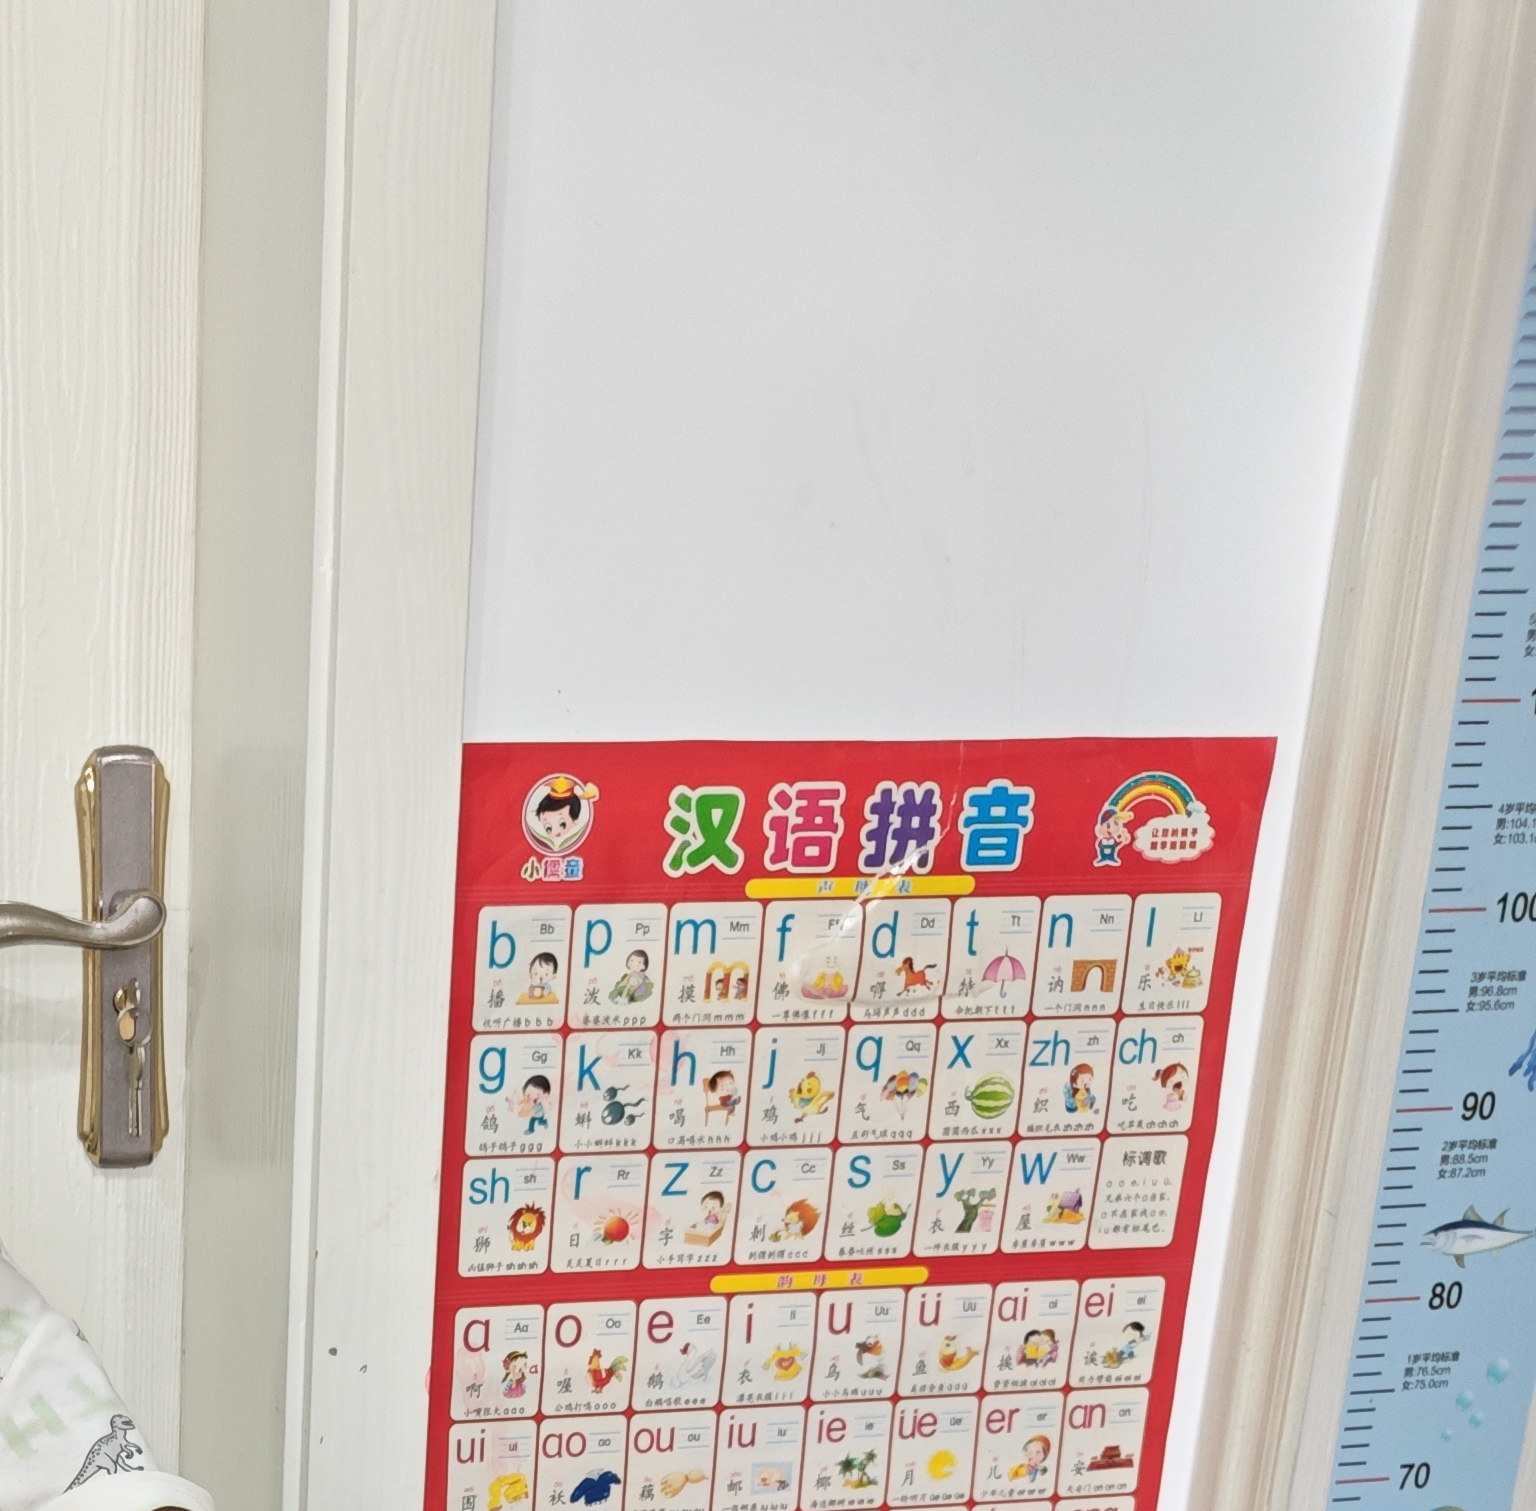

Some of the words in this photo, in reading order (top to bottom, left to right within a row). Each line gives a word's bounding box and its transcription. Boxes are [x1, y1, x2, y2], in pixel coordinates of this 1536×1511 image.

[1498, 802, 1536, 815] 4岁平均
[666, 782, 1032, 873] 汉语拼音
[539, 923, 555, 935] Bb
[635, 923, 650, 936] Pp
[729, 921, 750, 933] Mm
[872, 910, 899, 958] d
[921, 917, 935, 929] Dd
[966, 909, 979, 956] t
[1048, 912, 1073, 948] n
[1099, 913, 1115, 925] Nn
[489, 920, 516, 969] b
[584, 918, 612, 968] p
[674, 918, 717, 954] m
[776, 913, 795, 962] f
[1471, 970, 1527, 983] 3岁平均标准
[532, 1050, 548, 1064] Gg
[628, 1048, 642, 1059] Kk
[720, 1045, 736, 1057] Hh
[855, 1034, 883, 1083] q
[905, 1041, 921, 1053] Qq
[946, 1034, 975, 1069] x
[1029, 1030, 1071, 1066] zh
[1118, 1028, 1157, 1064] ch
[479, 1046, 506, 1094] g
[577, 1044, 602, 1091] k
[670, 1039, 696, 1086] h
[762, 1038, 778, 1090] j
[855, 1102, 870, 1121] 气
[944, 1100, 961, 1117] 西
[1461, 1091, 1496, 1121] 90
[1122, 1150, 1167, 1167] 标调歌
[1441, 1138, 1498, 1152] 2岁平均标准
[617, 1169, 630, 1181] Rr
[751, 1159, 776, 1193] c
[801, 1162, 816, 1174] Cc
[847, 1155, 871, 1188] s
[892, 1160, 906, 1172] Ss
[935, 1152, 964, 1198] y
[981, 1156, 994, 1169] Yy
[1020, 1152, 1058, 1185] w
[468, 1167, 510, 1205] sh
[574, 1166, 592, 1200] r
[661, 1162, 689, 1196] z
[570, 1233, 580, 1248] 日
[658, 1228, 673, 1247] 字
[918, 1292, 942, 1326] ü
[998, 1287, 1029, 1322] ai
[1084, 1283, 1116, 1318] ei
[1428, 1281, 1463, 1311] 80
[514, 1322, 529, 1333] Aa
[555, 1314, 582, 1348] o
[605, 1318, 621, 1329] Oo
[647, 1310, 674, 1344] e
[696, 1314, 711, 1325] Ee
[827, 1301, 852, 1335] u
[463, 1319, 490, 1352] a
[727, 1415, 757, 1449] iu
[817, 1410, 847, 1444] ie
[898, 1408, 938, 1440] üe
[985, 1407, 1021, 1434] er
[1068, 1402, 1106, 1430] an
[456, 1429, 486, 1464] ui
[542, 1431, 587, 1458] ao
[633, 1426, 675, 1454] ou
[902, 1469, 914, 1487] 月
[987, 1465, 1002, 1481] 儿
[1399, 1462, 1431, 1490] 70
